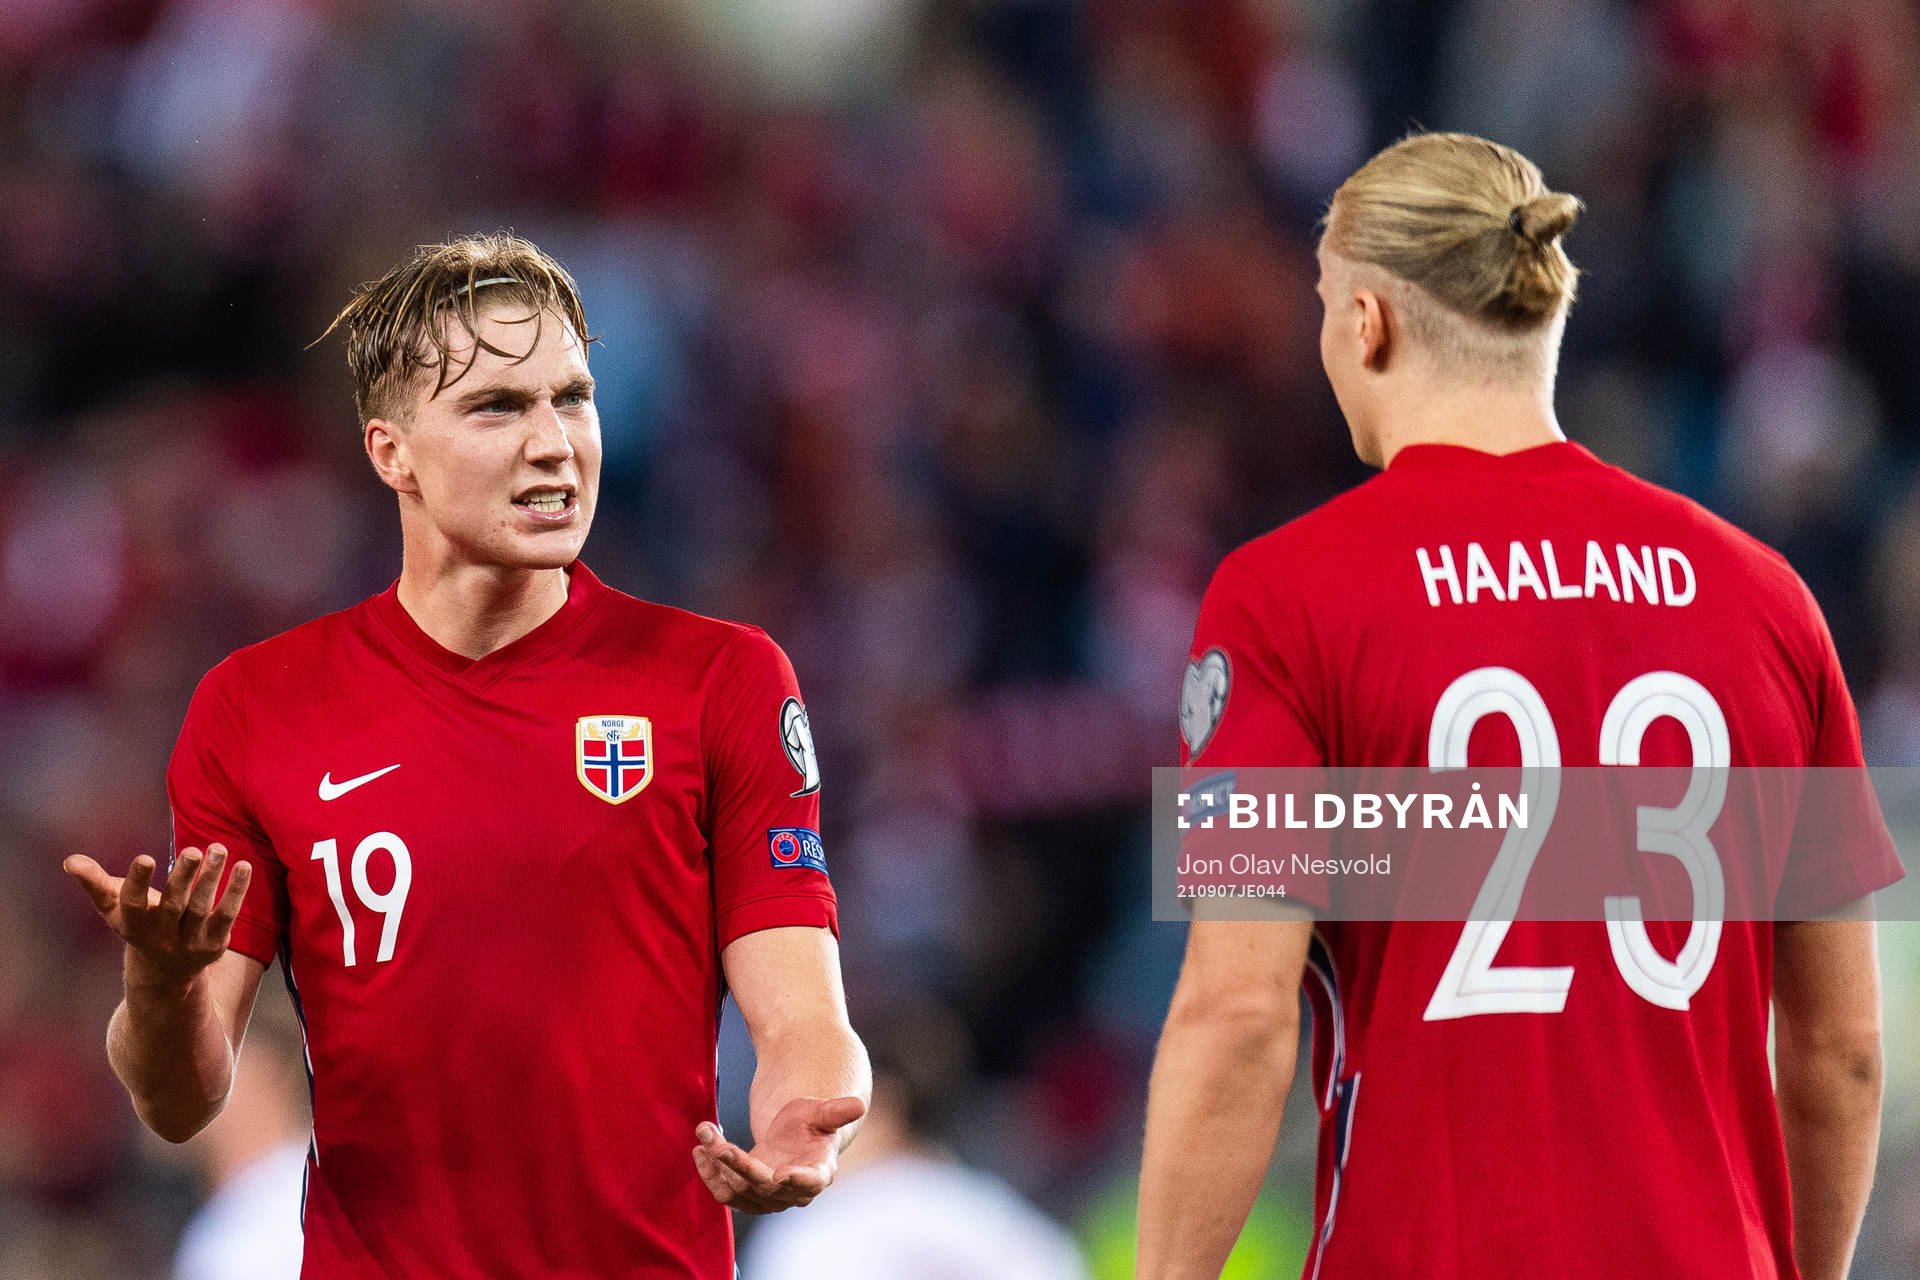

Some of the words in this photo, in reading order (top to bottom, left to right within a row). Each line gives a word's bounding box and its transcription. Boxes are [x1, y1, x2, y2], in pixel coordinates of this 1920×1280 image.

[1416, 540, 1697, 607] HAALAND
[601, 720, 625, 728] NORGE
[1423, 665, 1732, 1022] 23
[310, 831, 413, 967] 19
